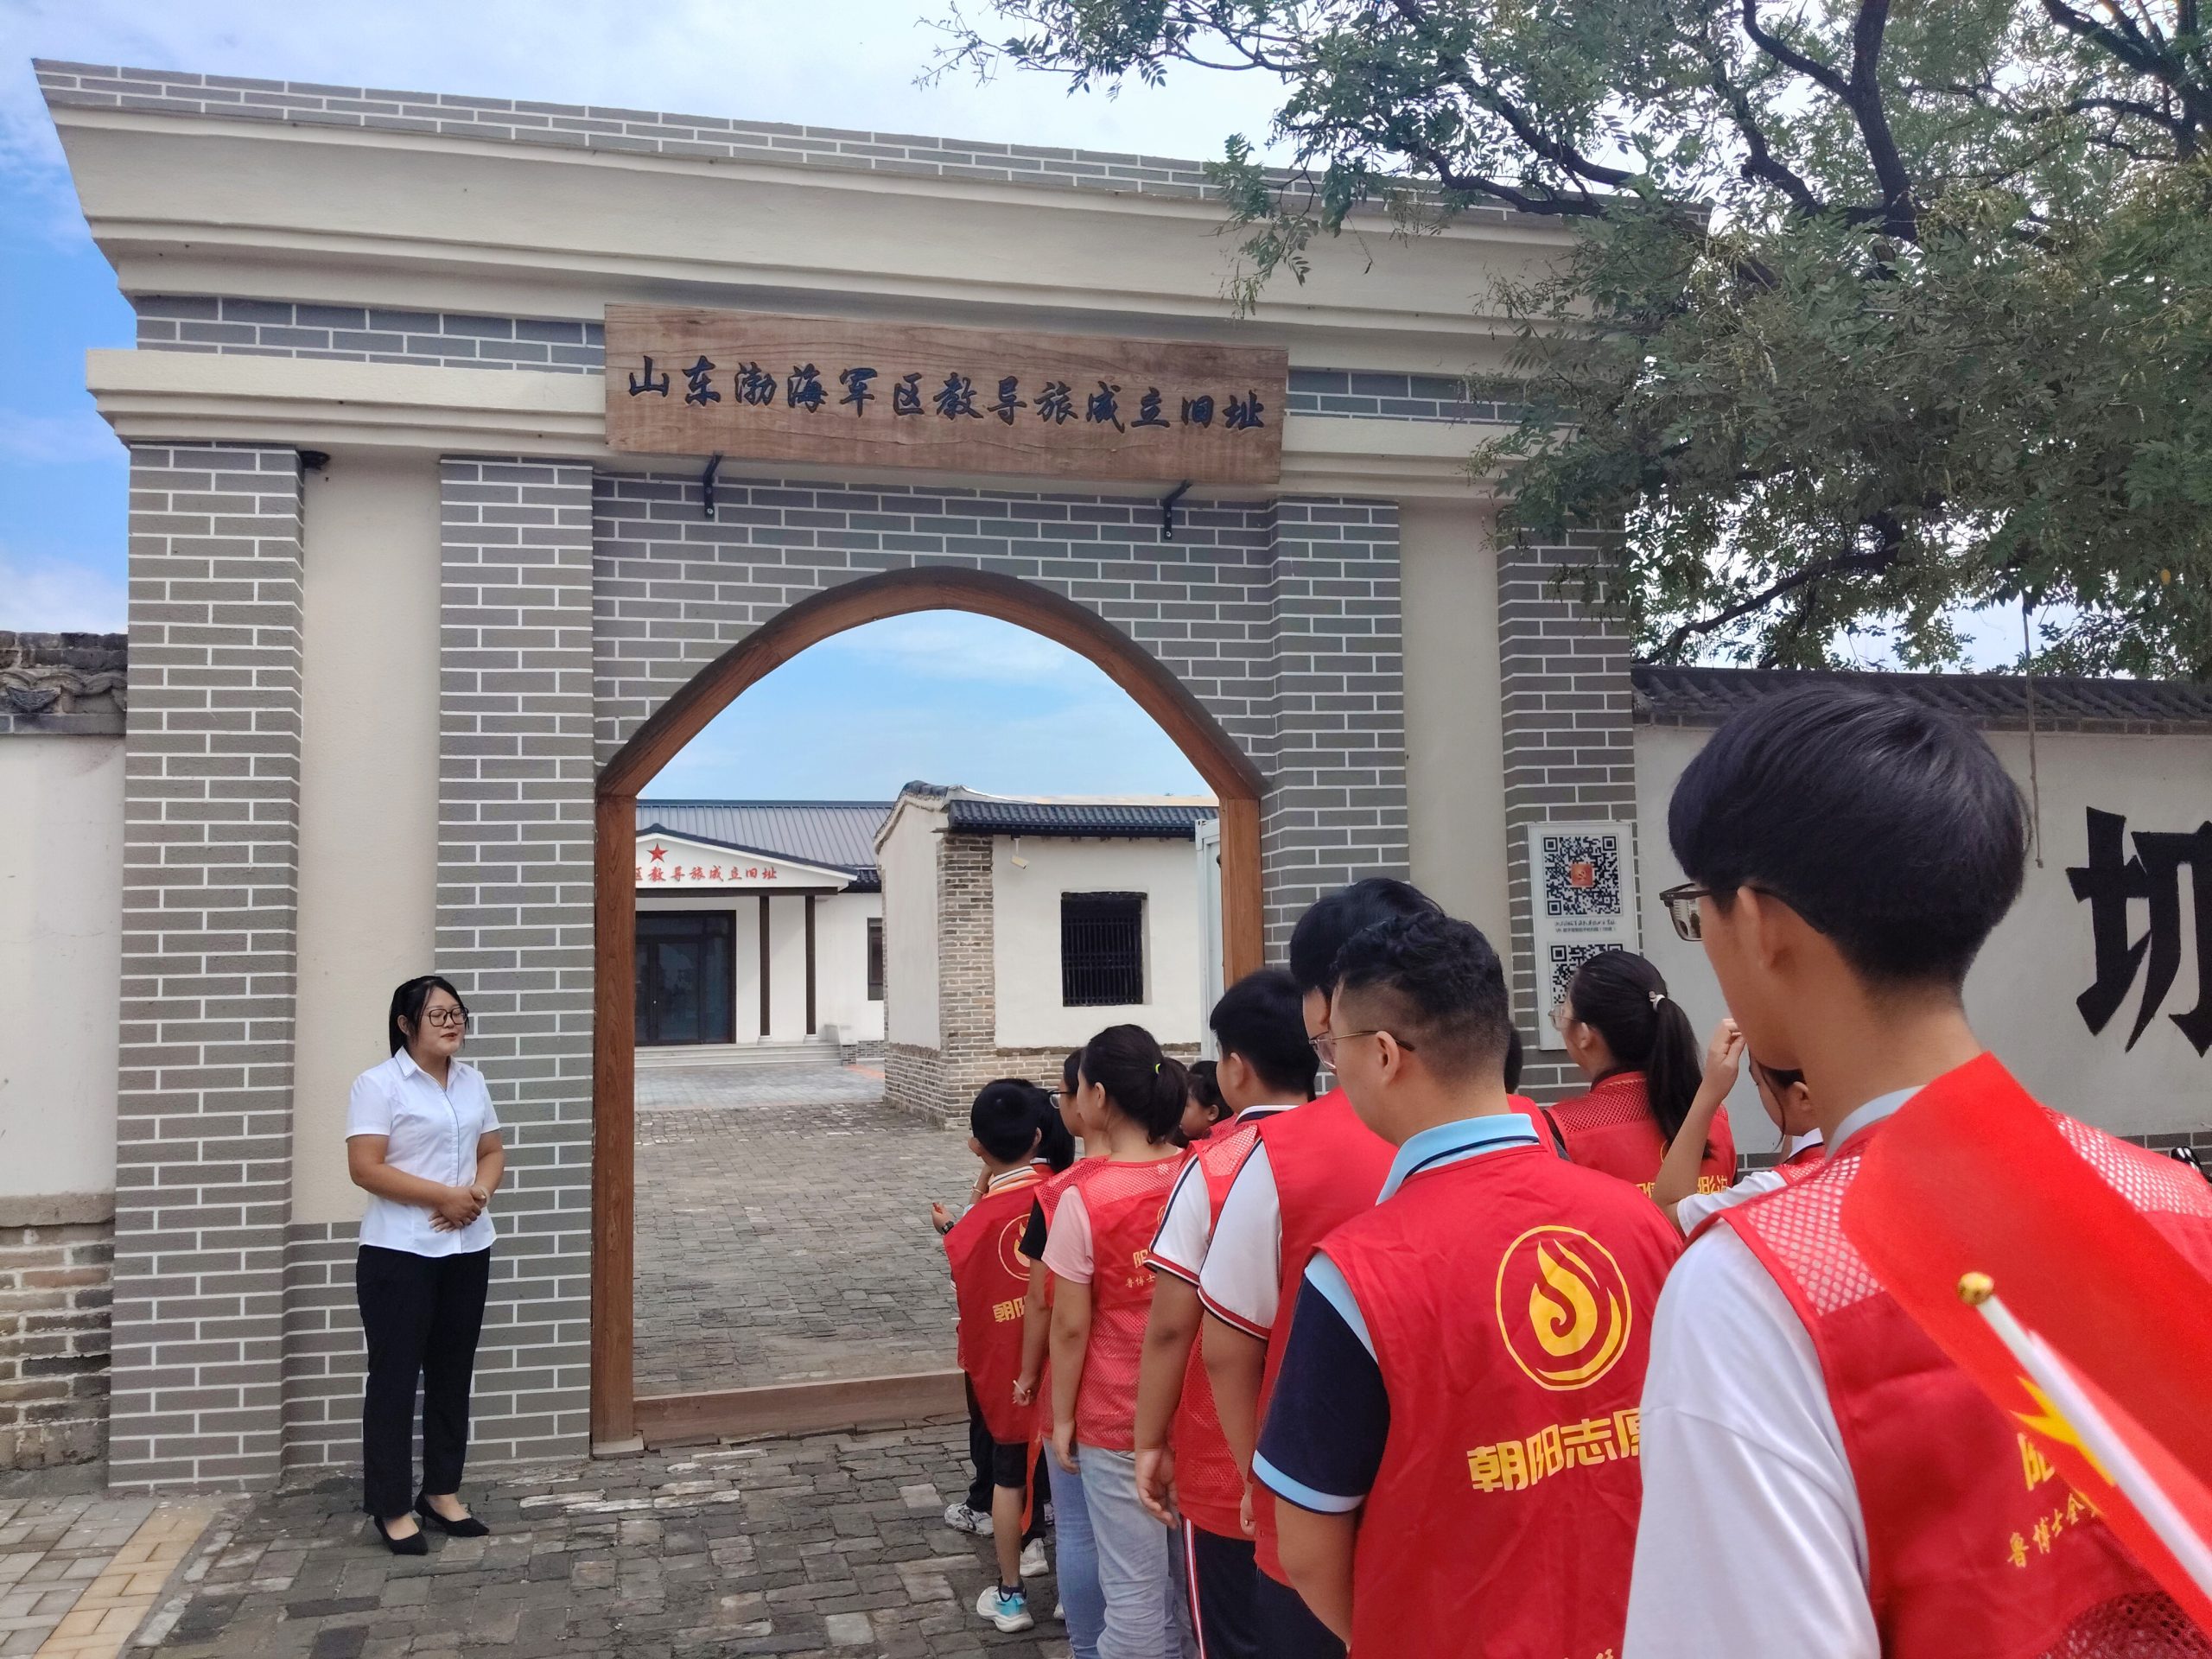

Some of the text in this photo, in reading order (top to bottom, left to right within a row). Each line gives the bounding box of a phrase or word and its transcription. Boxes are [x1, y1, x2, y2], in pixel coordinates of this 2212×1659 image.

[629, 353, 1265, 434] 山东渤海军区教导旅成立旧址
